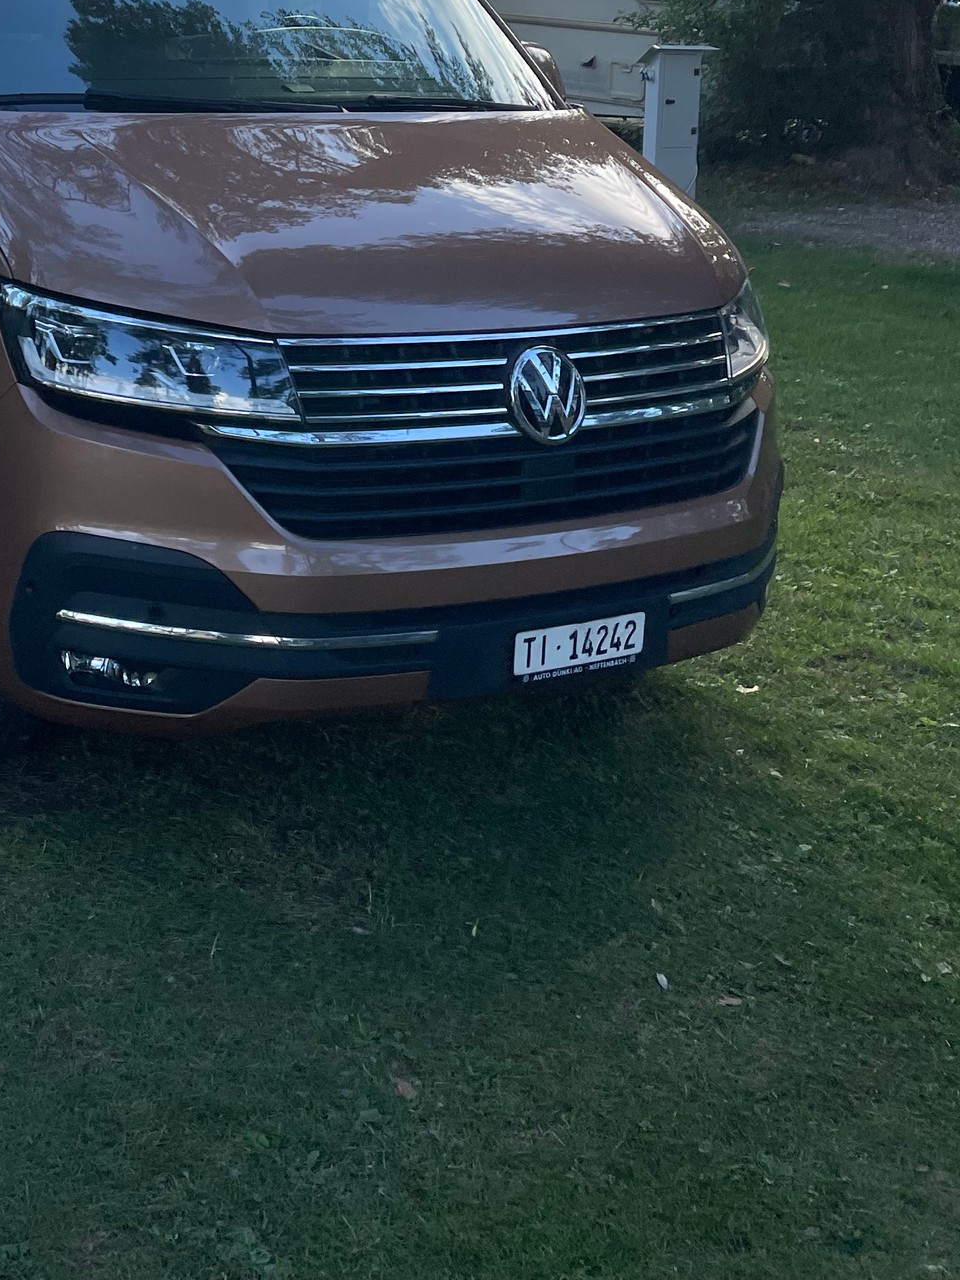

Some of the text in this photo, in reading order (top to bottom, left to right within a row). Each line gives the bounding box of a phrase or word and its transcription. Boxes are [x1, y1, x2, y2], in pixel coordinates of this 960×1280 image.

[523, 634, 547, 668] TI
[569, 620, 637, 660] 14242
[533, 672, 551, 681] AUTO
